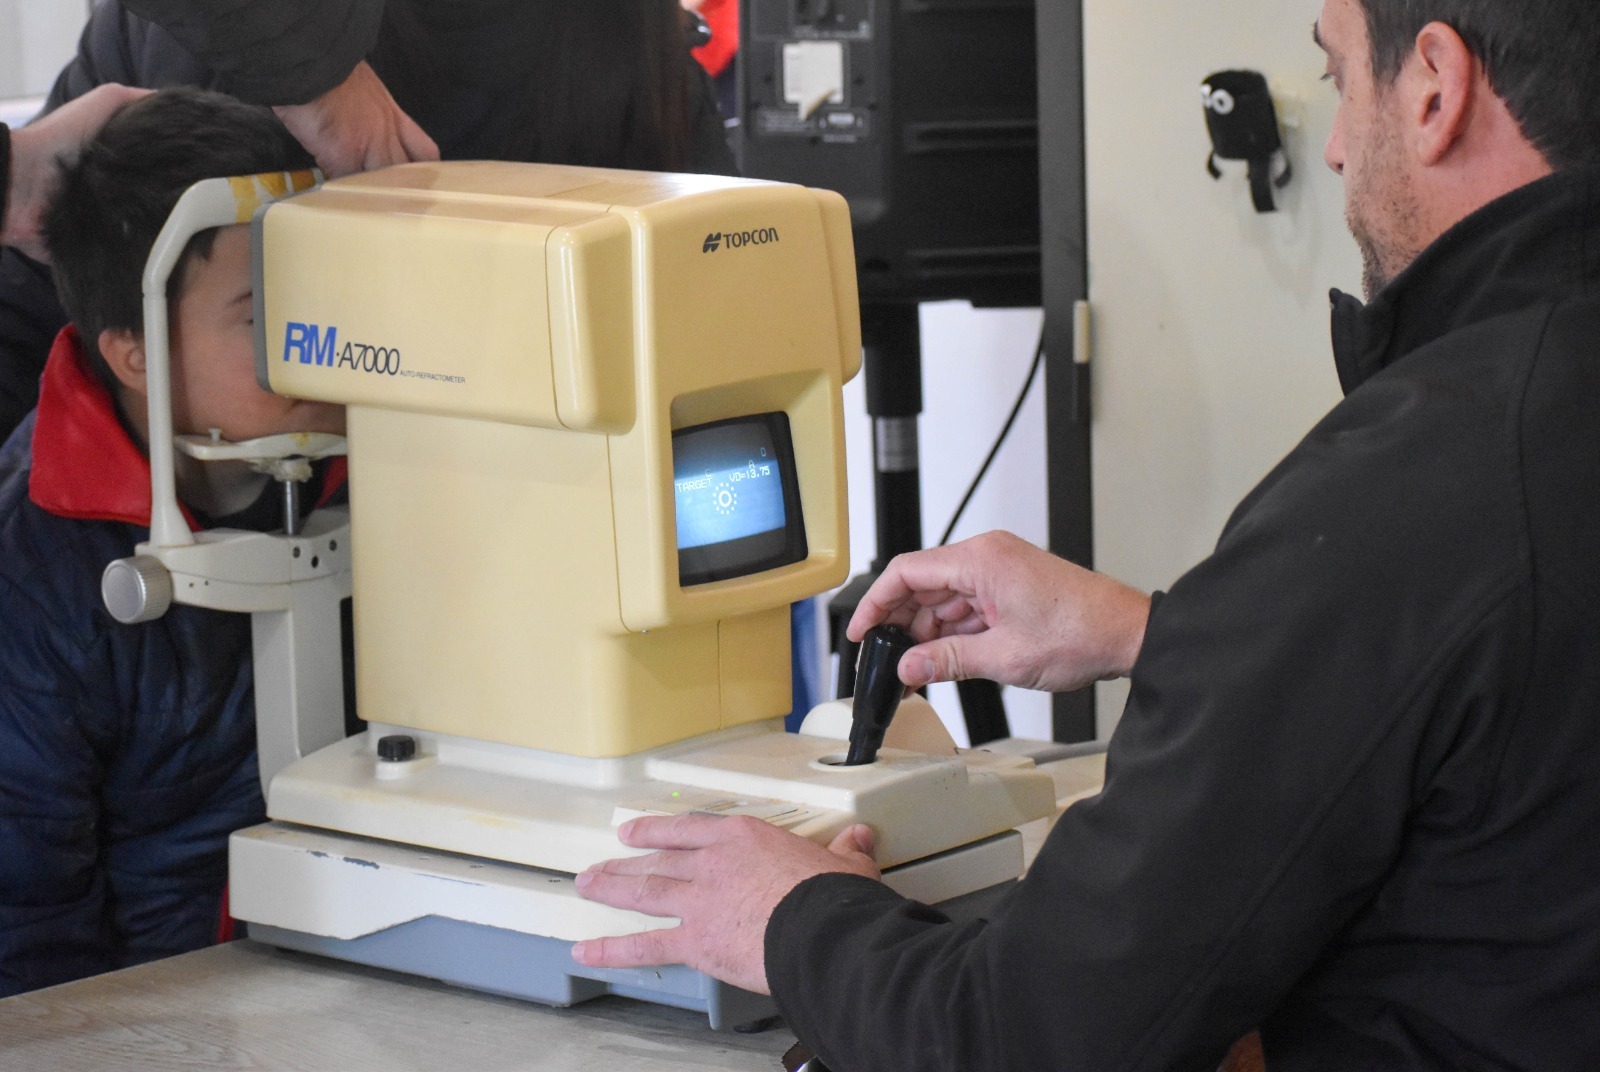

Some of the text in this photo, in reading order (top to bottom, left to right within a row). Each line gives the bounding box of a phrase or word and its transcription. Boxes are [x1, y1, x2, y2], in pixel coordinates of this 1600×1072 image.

[722, 227, 780, 249] TOPCON
[399, 369, 466, 384] AUTO-REFRACTOMETER
[676, 465, 771, 492] TARGET VD=13.75
